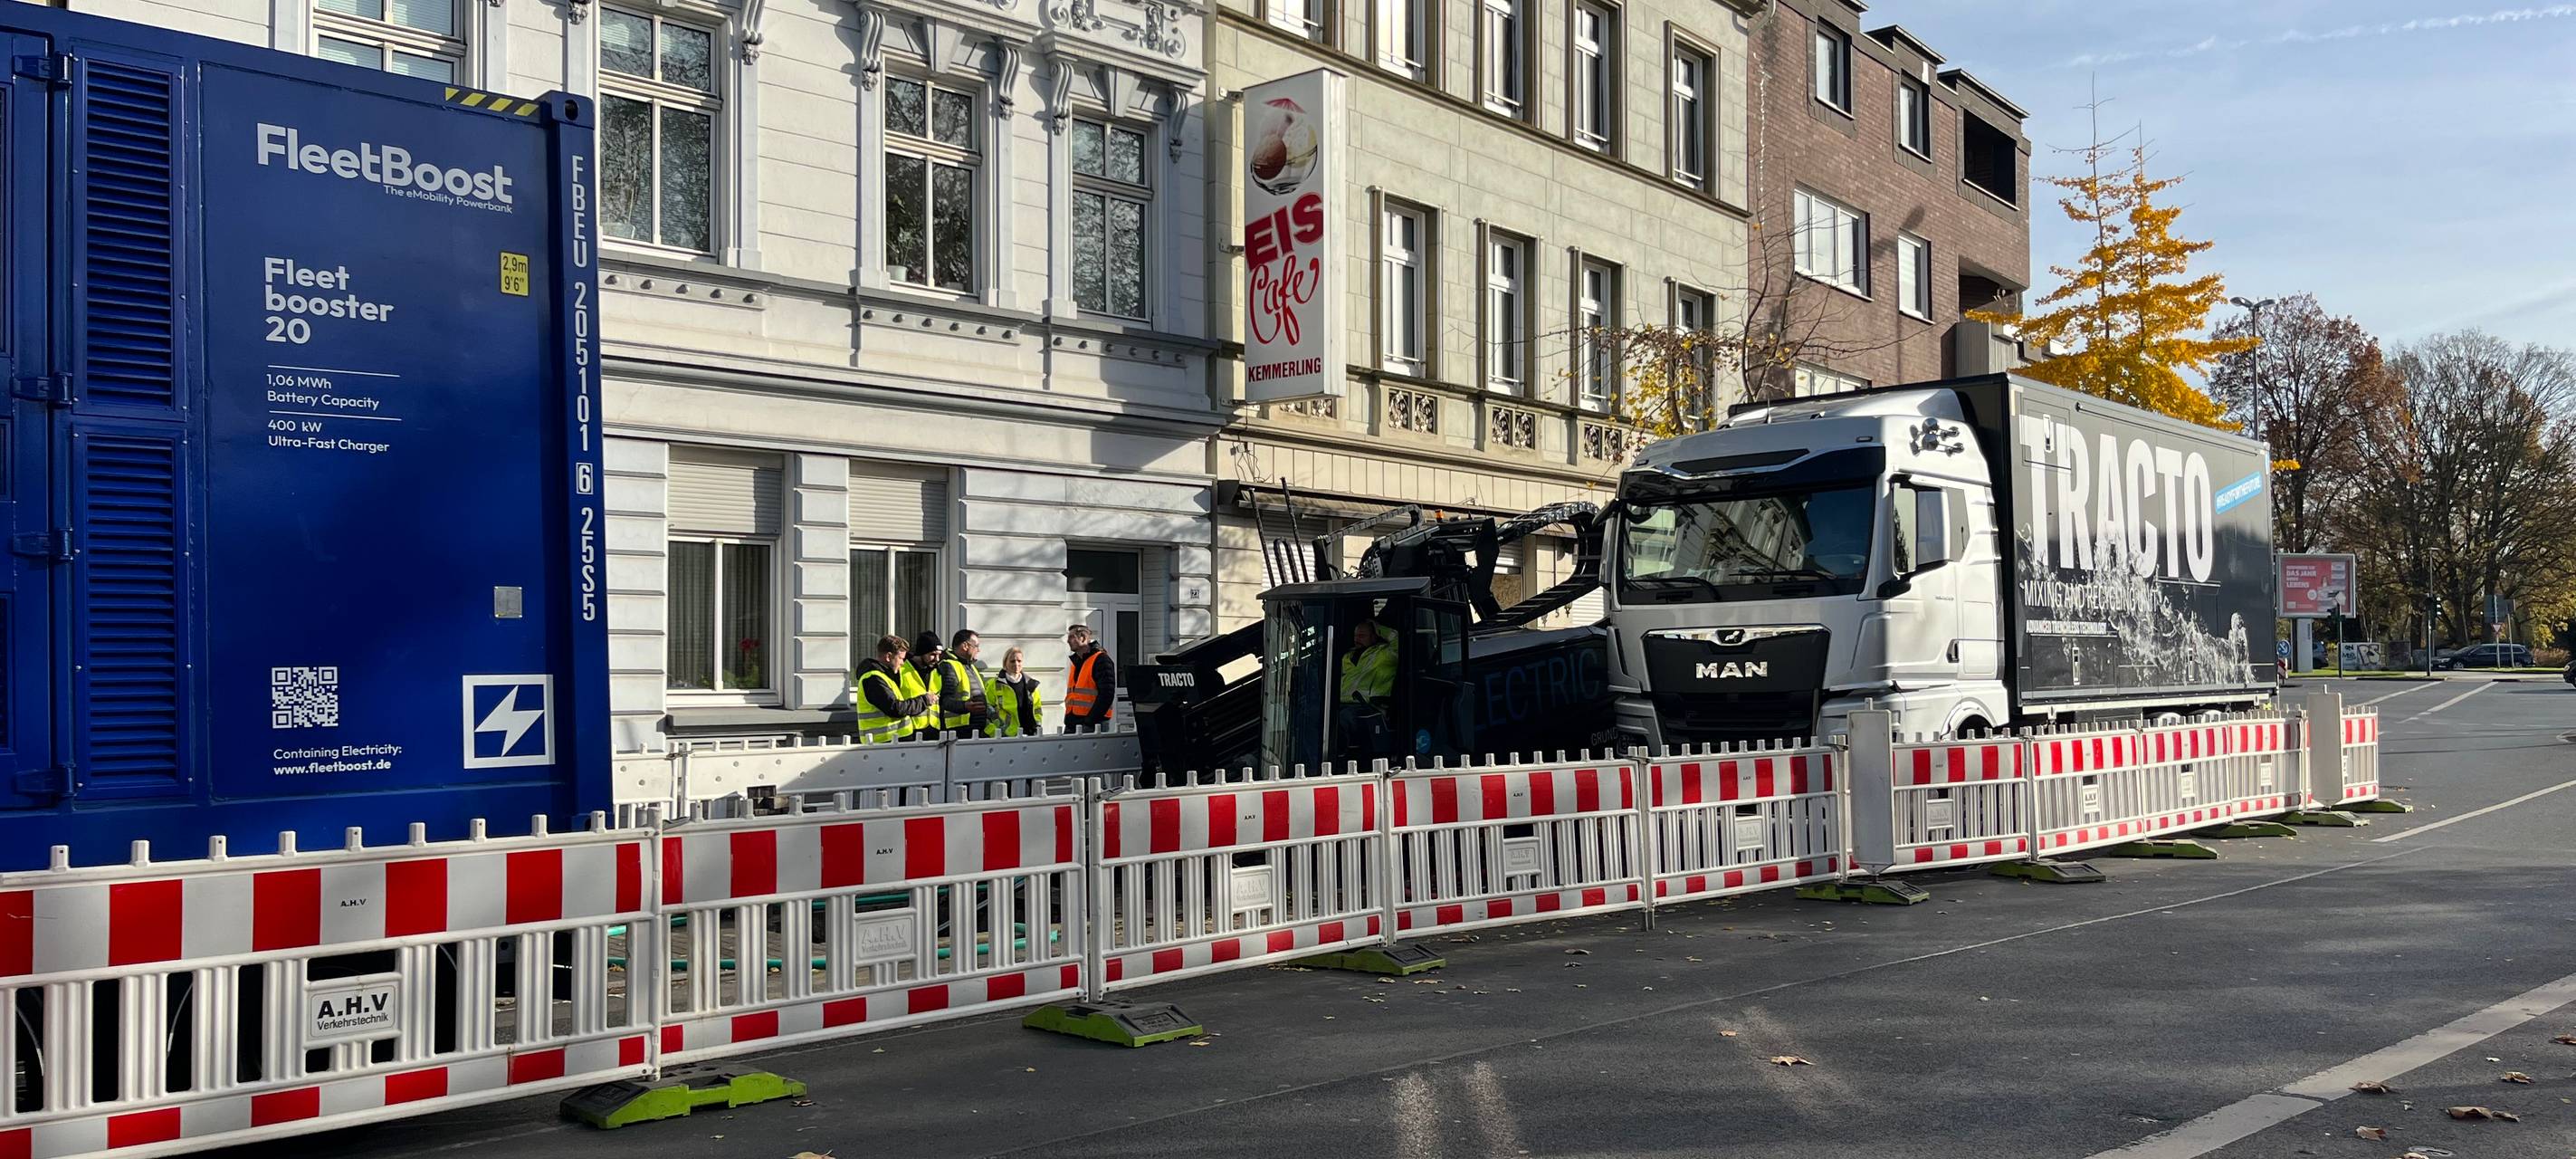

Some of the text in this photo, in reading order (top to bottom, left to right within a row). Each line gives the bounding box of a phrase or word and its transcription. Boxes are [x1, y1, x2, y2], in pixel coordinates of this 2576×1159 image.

[256, 122, 513, 204] FleetBoost
[383, 185, 512, 214] The eMobility Powerbank
[571, 156, 587, 268] FBEU
[1245, 192, 1323, 272] EIS
[264, 256, 349, 291] Fleet
[502, 255, 527, 273] 2,9m
[265, 284, 394, 322] booster
[265, 317, 310, 344] 20
[574, 282, 589, 451] 205101
[1248, 358, 1321, 383] KEMMERLING
[266, 374, 332, 389] 1,06 MWh
[267, 390, 379, 411] Battery Capacity
[268, 419, 322, 432] 400 kW
[268, 436, 390, 454] Ultra-Fast Charger
[2019, 414, 2214, 582] TRACTO
[2025, 580, 2062, 608] MIXING
[2065, 583, 2085, 609] AND
[1158, 672, 1195, 687] TRACTO
[1695, 661, 1768, 678] MAN
[273, 744, 402, 759] Containing Electricity:
[273, 759, 392, 775] www.fleetboost.de
[340, 898, 367, 907] A.H.V
[862, 924, 905, 944] A.H.V
[318, 992, 388, 1019] A.H.V
[317, 1012, 389, 1030] Verkehrstechnik
